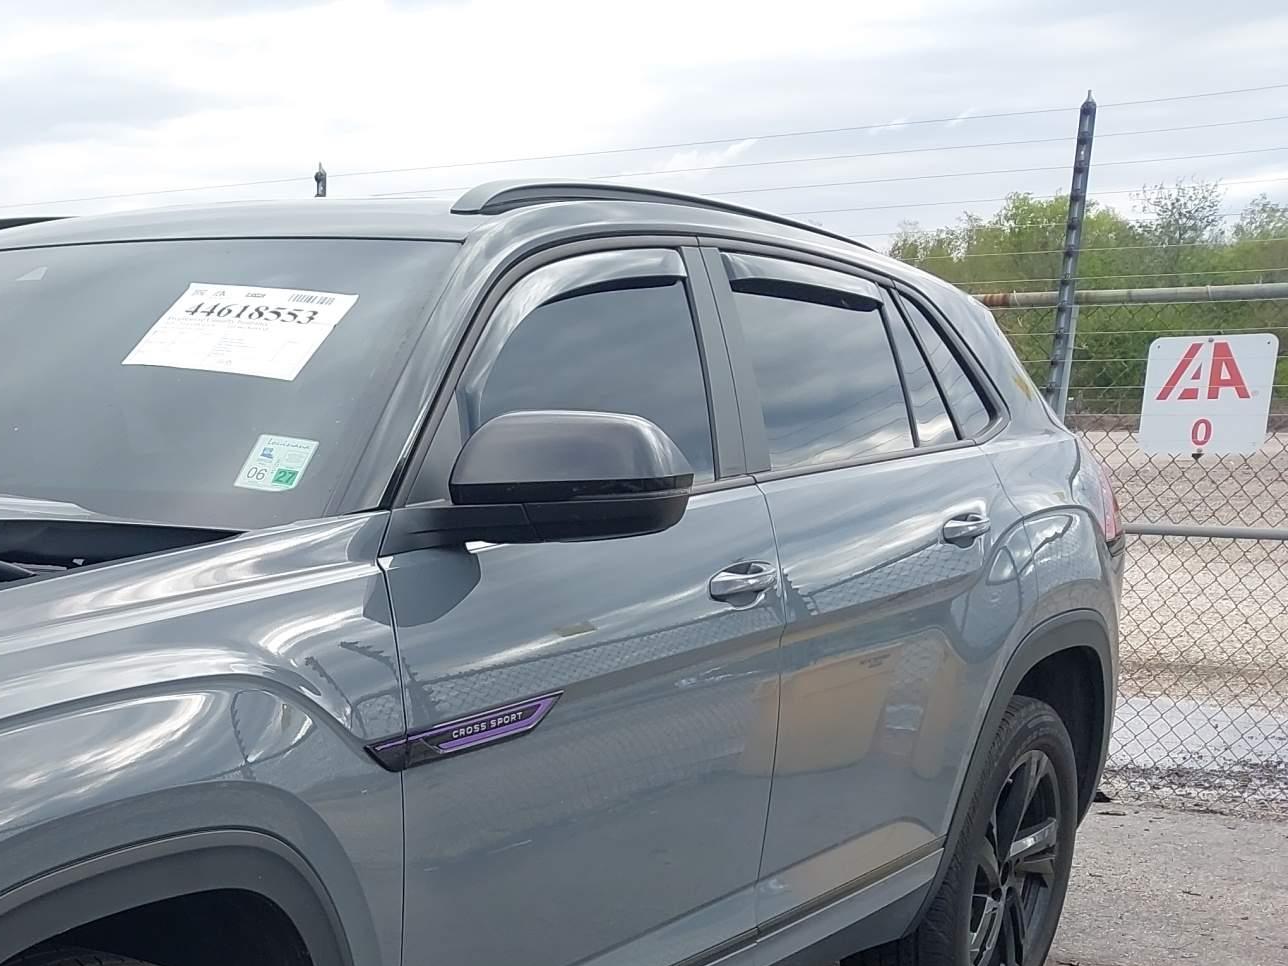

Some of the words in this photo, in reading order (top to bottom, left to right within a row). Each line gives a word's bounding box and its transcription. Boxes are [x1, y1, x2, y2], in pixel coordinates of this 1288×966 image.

[185, 302, 319, 324] 44618553
[1191, 418, 1213, 446] 0
[247, 466, 268, 481] 06
[274, 471, 297, 484] 27
[452, 722, 487, 738] CROSS
[490, 711, 523, 728] SPORT
